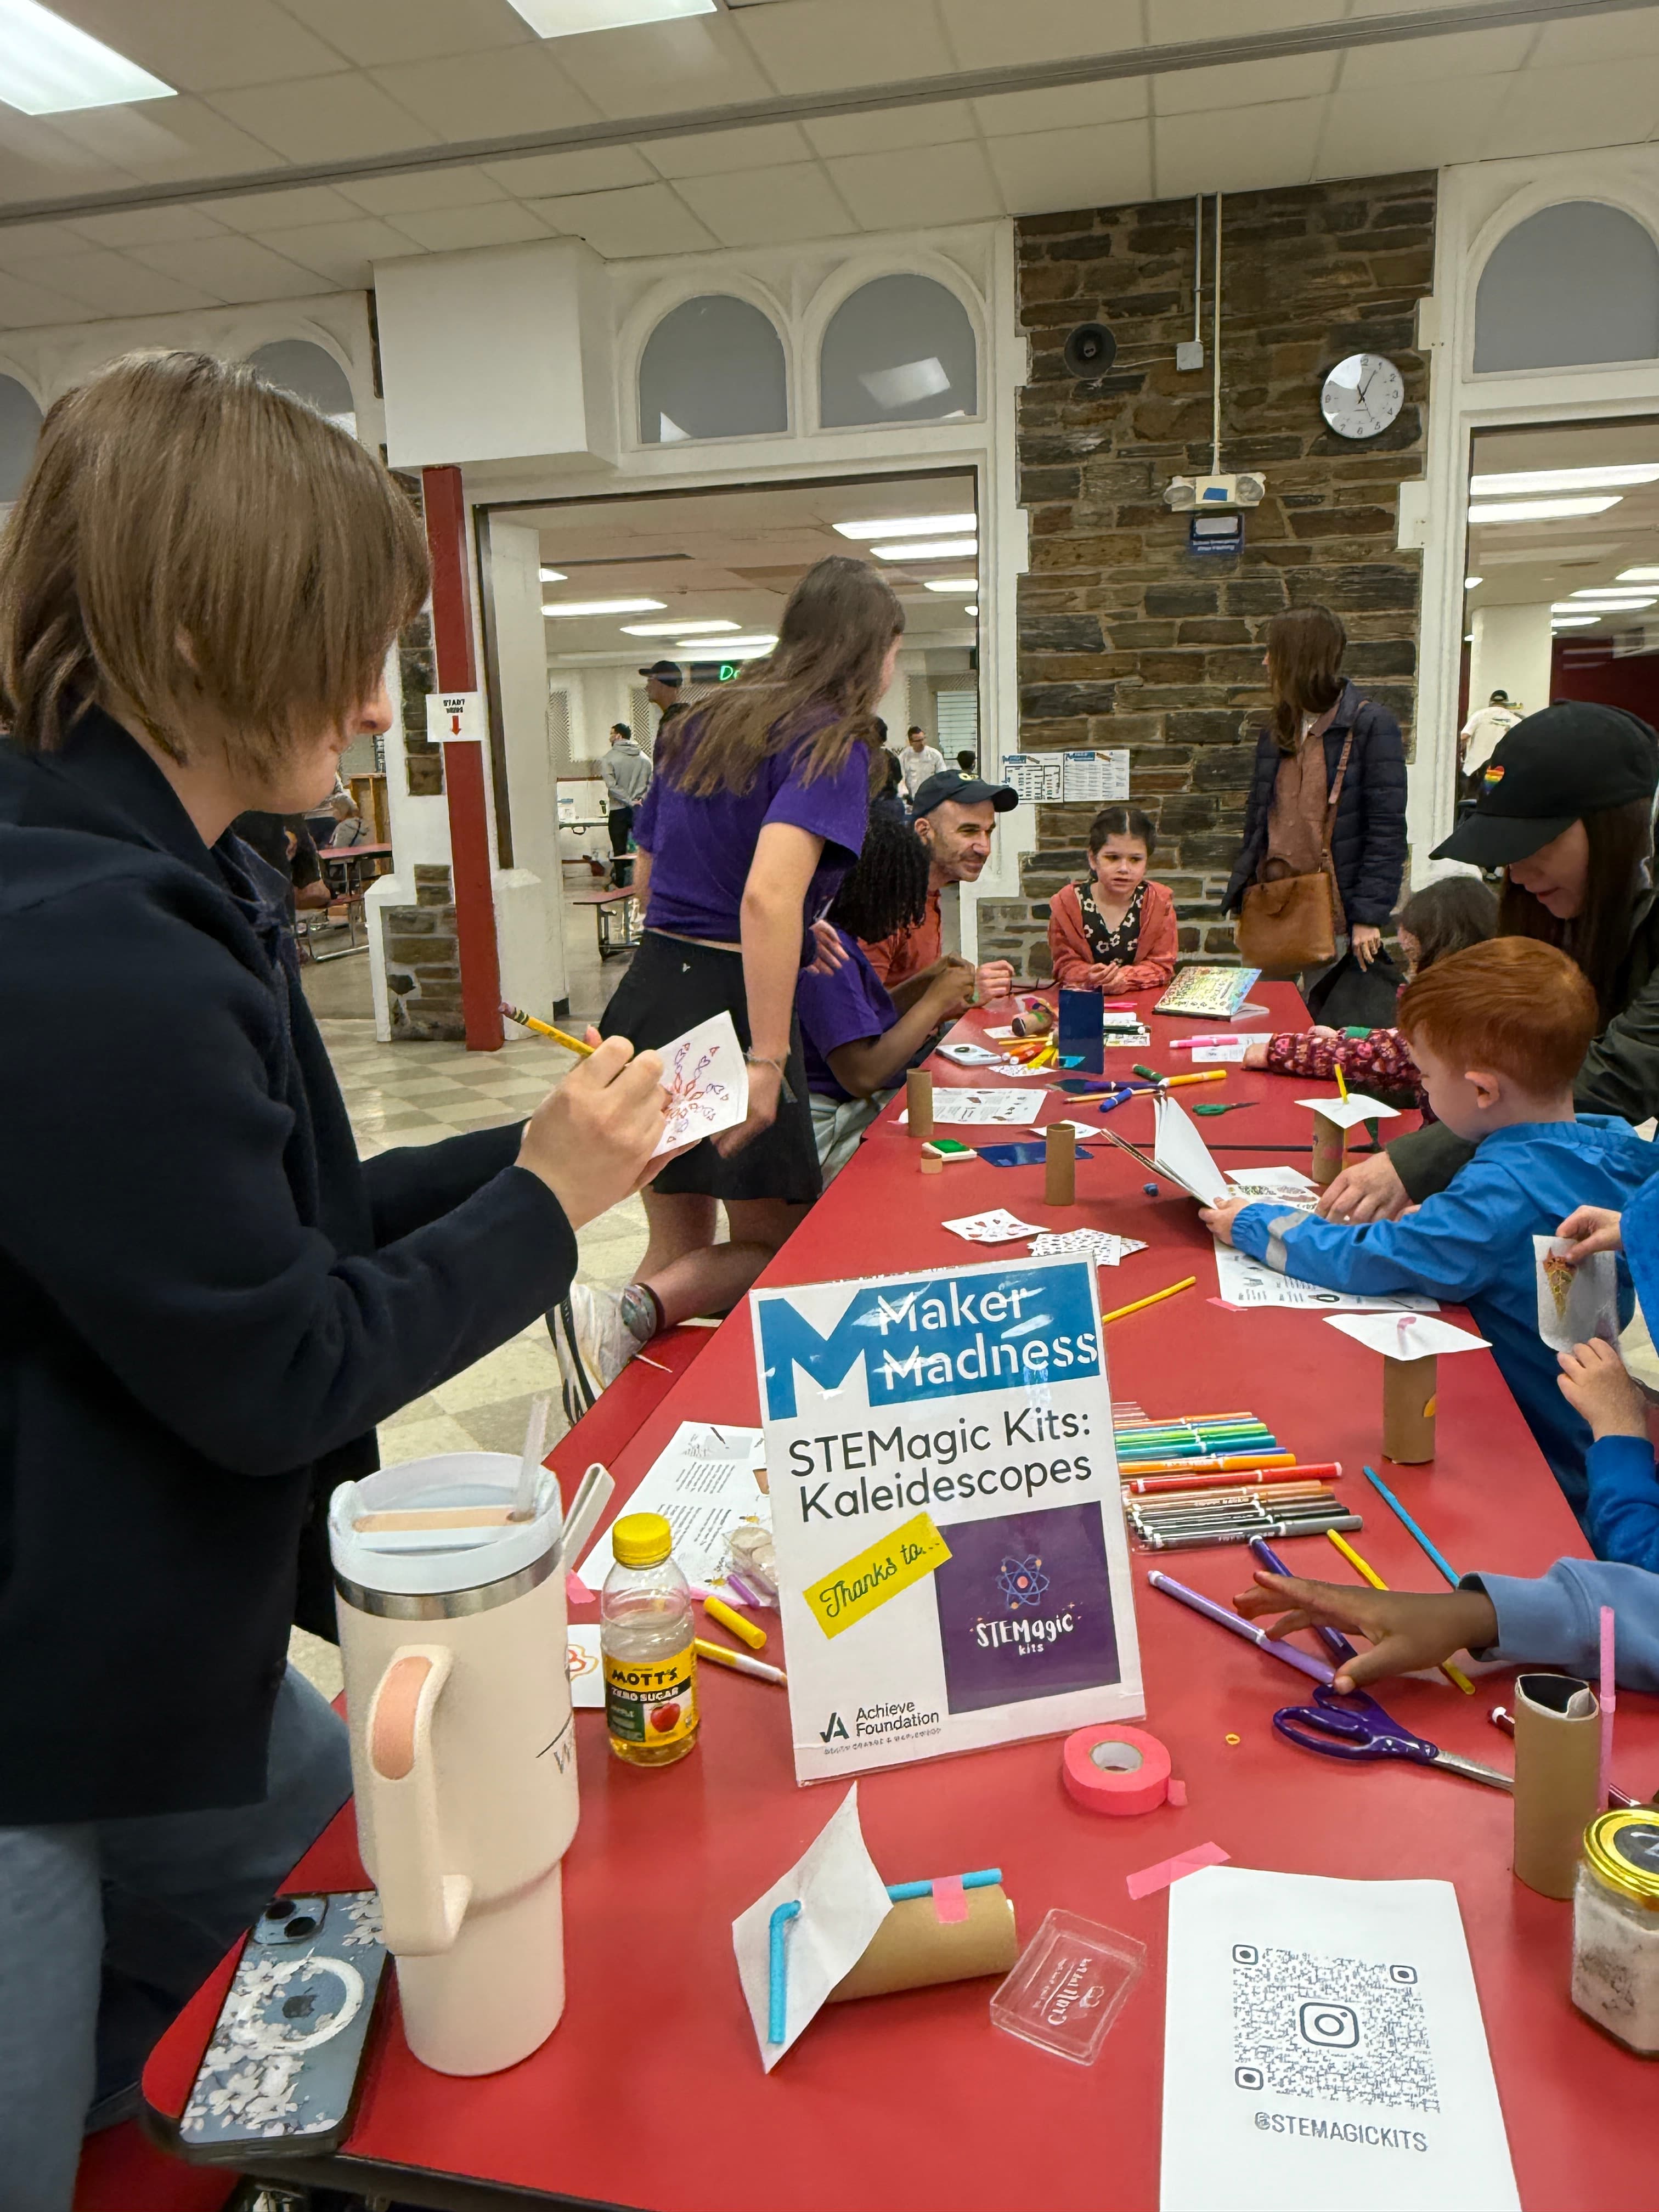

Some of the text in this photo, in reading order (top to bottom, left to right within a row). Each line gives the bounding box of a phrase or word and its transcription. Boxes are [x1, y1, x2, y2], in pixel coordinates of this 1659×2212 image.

[878, 1282, 1028, 1335] Maker
[883, 1333, 1097, 1390] Madness
[789, 1407, 1090, 1477] STEMagic Kits:
[800, 1455, 1092, 1522] Kaleidescopes
[820, 1557, 898, 1617] Thanks
[1018, 1643, 1044, 1656] kits
[612, 1667, 679, 1686] MOTT'S
[640, 1686, 679, 1701] SUGAR
[856, 1702, 915, 1722] Achieve
[856, 1712, 939, 1737] Foundation
[1254, 2112, 1428, 2152] @STEMAGICKITS
